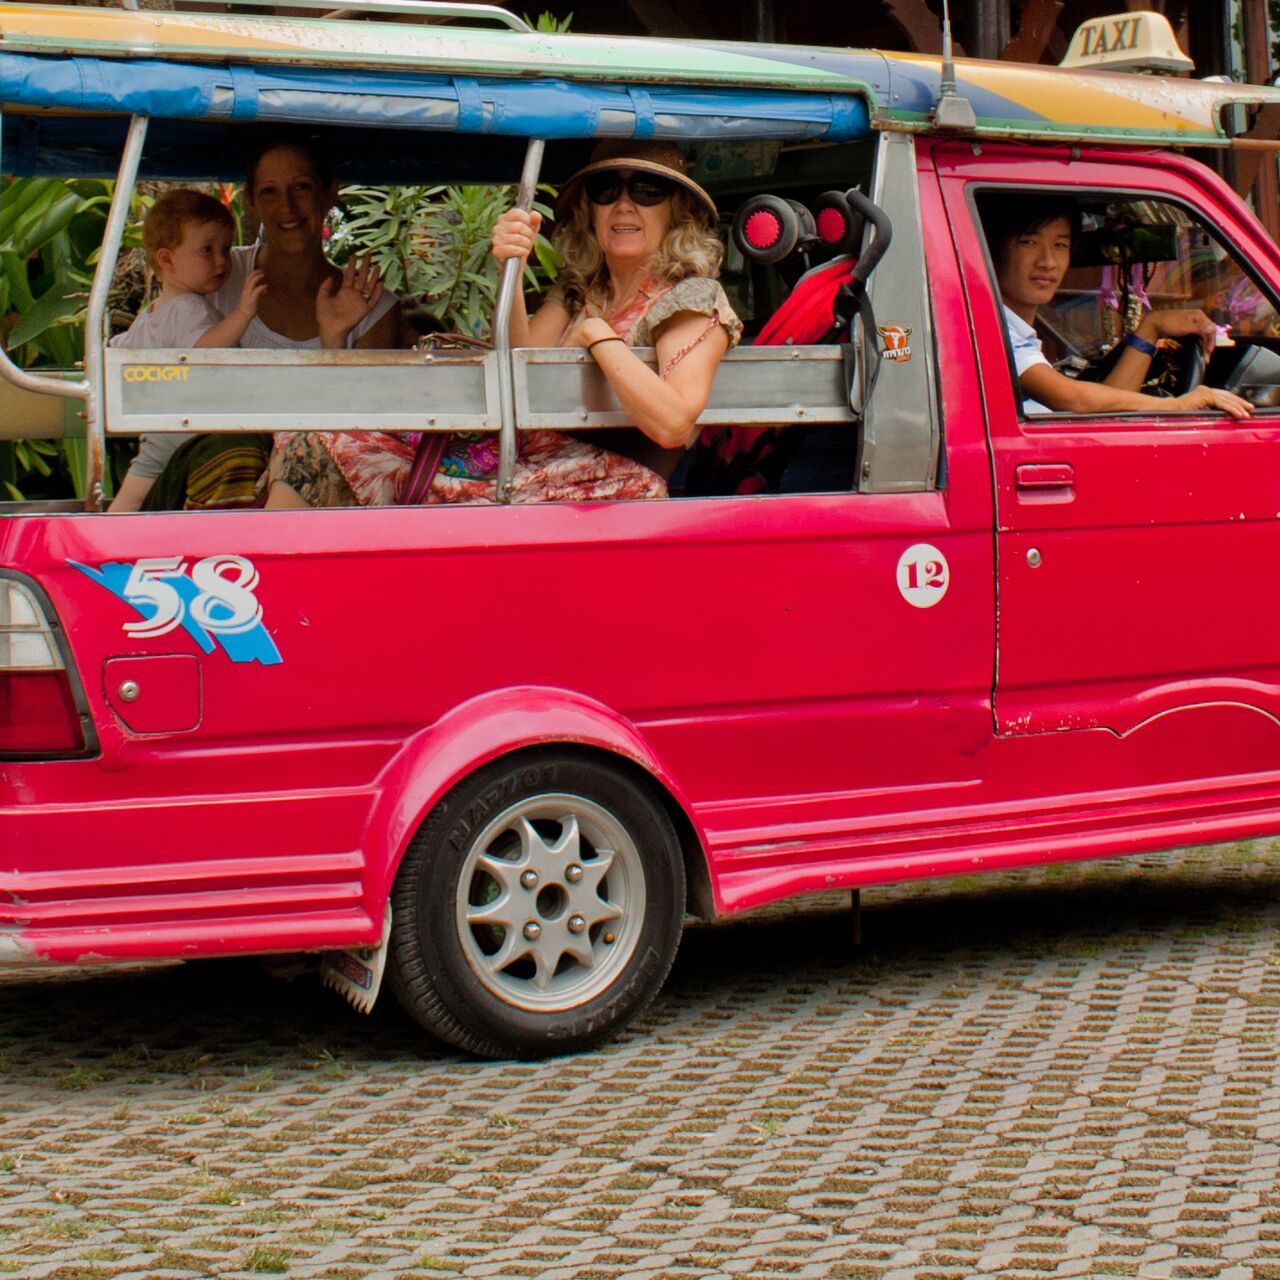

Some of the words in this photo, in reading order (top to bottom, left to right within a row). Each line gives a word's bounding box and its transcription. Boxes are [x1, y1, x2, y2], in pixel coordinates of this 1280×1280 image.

[1080, 17, 1143, 58] TAXI
[123, 365, 191, 383] COCKPIT
[902, 559, 946, 590] 12
[122, 554, 263, 638] 58
